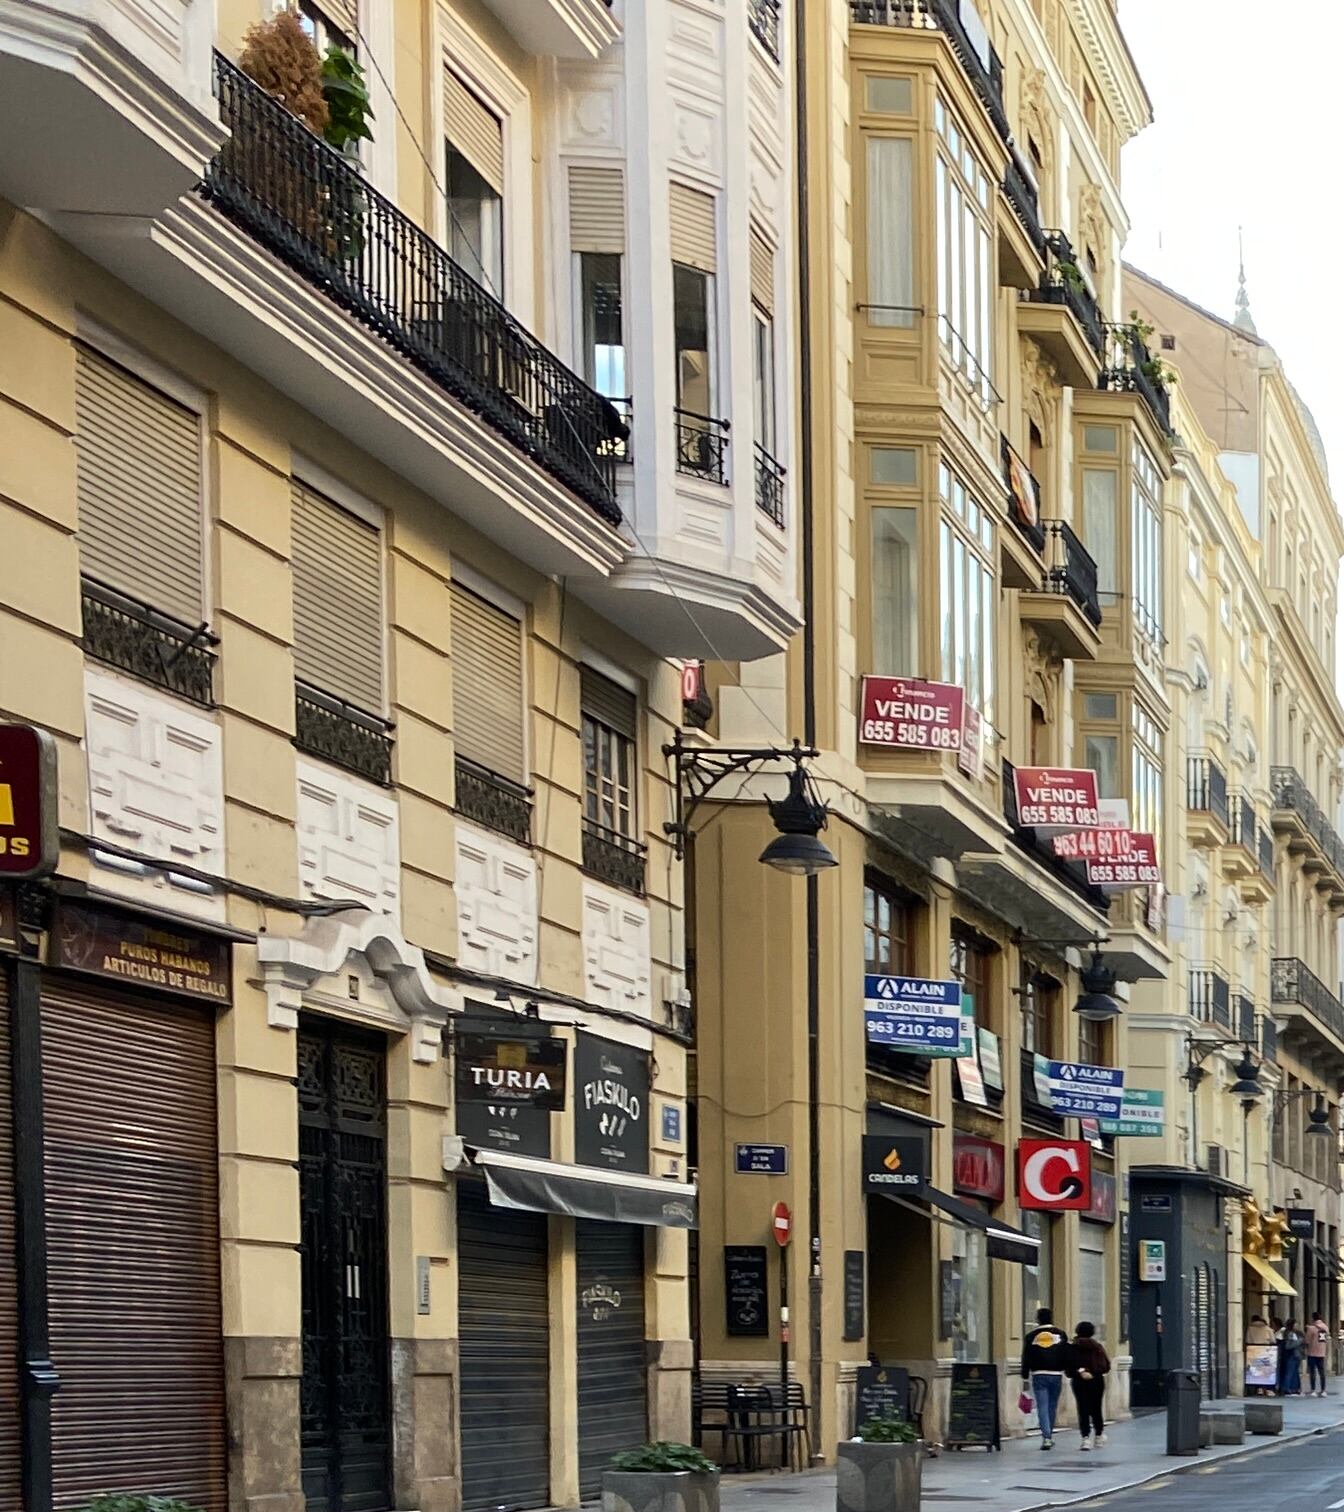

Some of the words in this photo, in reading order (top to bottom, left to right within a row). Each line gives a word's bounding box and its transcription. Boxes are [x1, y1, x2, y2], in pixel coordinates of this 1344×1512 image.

[875, 699, 950, 723] VENDE
[864, 720, 894, 741] 655
[897, 723, 927, 744] 585
[931, 727, 960, 748] 083
[1026, 787, 1088, 804] VENDE
[1021, 806, 1047, 823] 655
[1051, 806, 1074, 824] 585
[1076, 807, 1098, 825] 083
[1053, 834, 1078, 856] 963
[1080, 831, 1096, 855] 44
[1097, 831, 1113, 855] 60
[1091, 865, 1113, 881] 655
[1115, 865, 1137, 881] 585
[1138, 865, 1158, 881] 083
[121, 941, 158, 963] PUROS
[161, 951, 210, 976] HABANOS
[104, 955, 166, 984] ARTICULOS
[168, 971, 184, 987] DE
[186, 975, 226, 997] REGALO
[901, 982, 945, 997] ALAIN
[877, 1001, 944, 1015] DISPONIBLE
[867, 1021, 894, 1034] 963
[897, 1022, 924, 1036] 210
[927, 1025, 953, 1039] 289
[470, 1067, 551, 1090] TURIA
[1078, 1068, 1112, 1080] ALAIN
[1060, 1082, 1111, 1094] DISPONIBLE
[584, 1079, 640, 1121] FIASKILO
[1051, 1096, 1072, 1107] 963
[1073, 1099, 1094, 1110] 210
[1096, 1101, 1117, 1113] 289
[868, 1173, 919, 1185] CANDELAS
